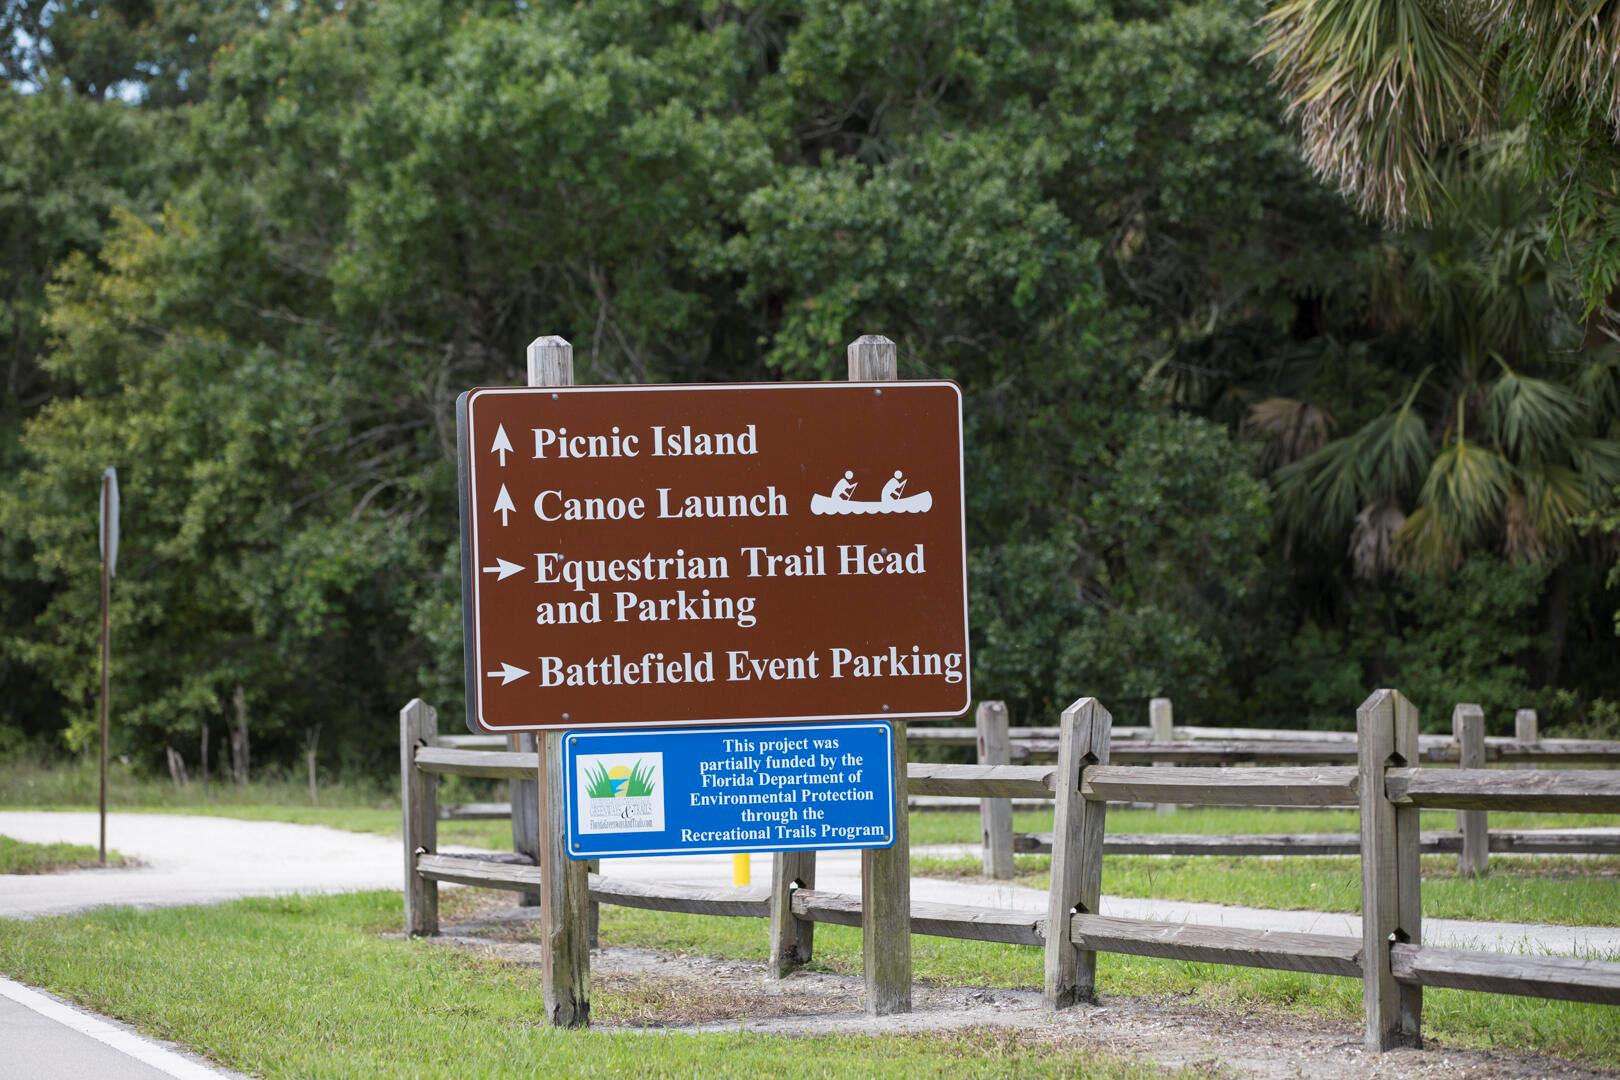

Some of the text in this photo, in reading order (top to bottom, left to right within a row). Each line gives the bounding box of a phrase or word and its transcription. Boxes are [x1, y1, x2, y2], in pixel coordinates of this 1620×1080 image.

[531, 425, 759, 459] Picnic Island
[534, 487, 789, 522] Canoe Launch
[533, 544, 926, 592] Equestrian Trail Head
[536, 590, 757, 628] and Parking
[538, 646, 963, 687] Battlefield Event Parking
[722, 738, 839, 756] This project was
[700, 753, 864, 774] partially funded by the
[701, 770, 863, 789] Florida Department of
[690, 788, 874, 806] Environmental Protection
[741, 807, 825, 825] through the
[681, 825, 885, 842] Recreational Trails Program
